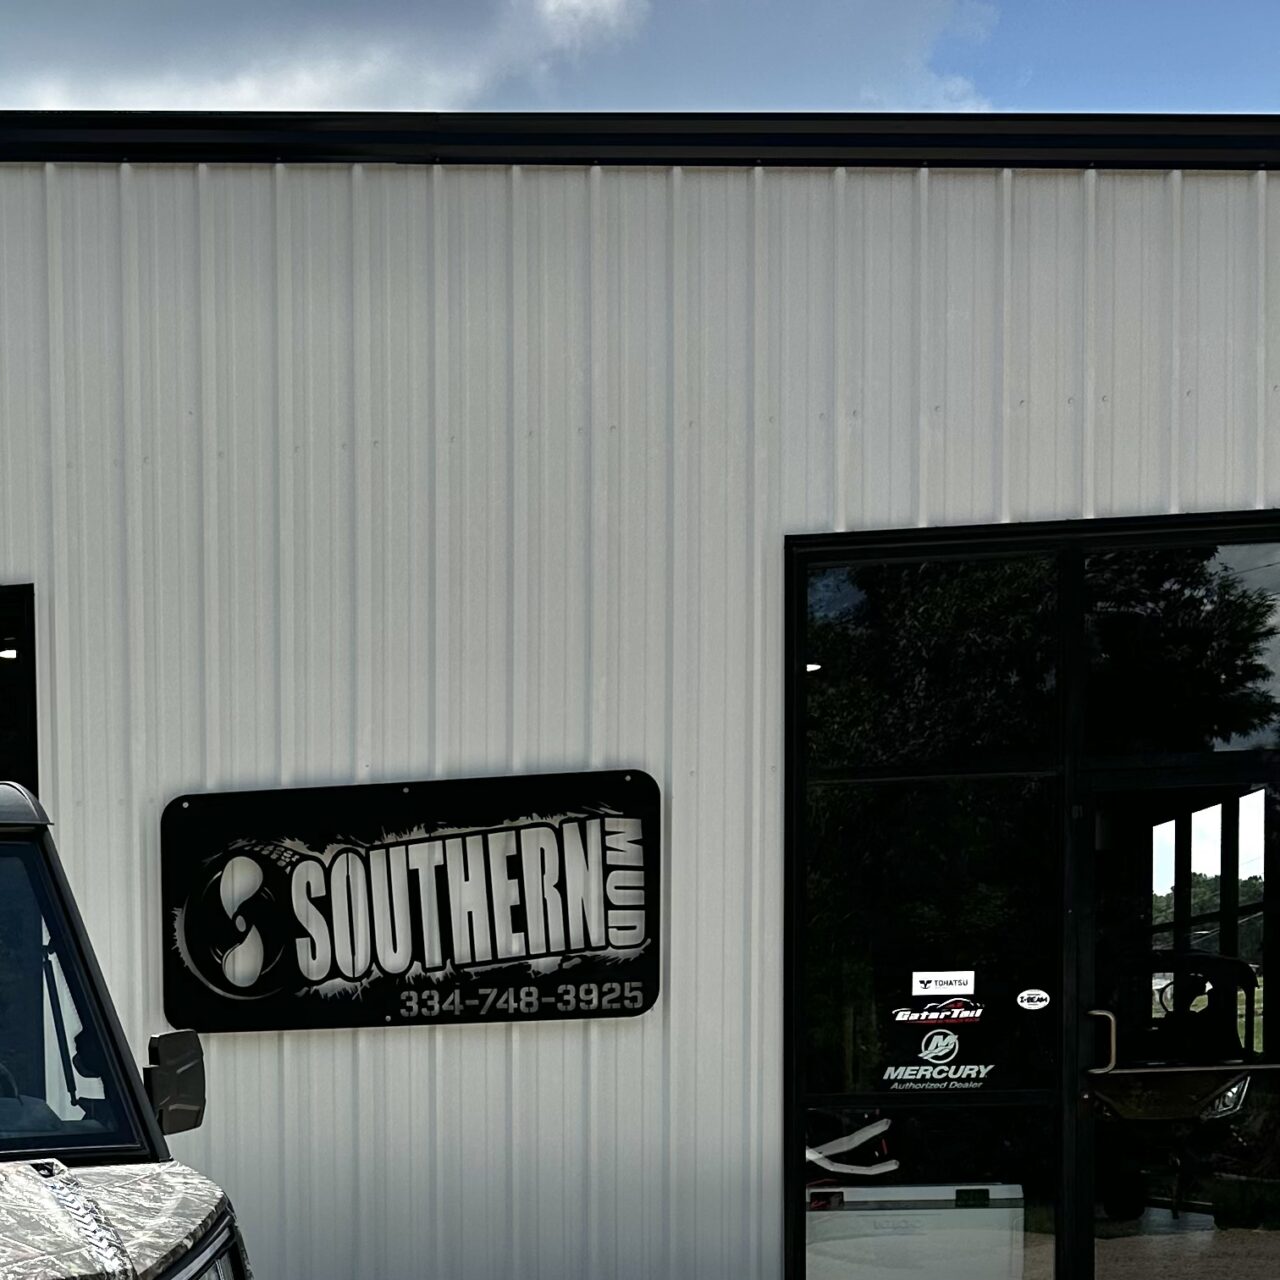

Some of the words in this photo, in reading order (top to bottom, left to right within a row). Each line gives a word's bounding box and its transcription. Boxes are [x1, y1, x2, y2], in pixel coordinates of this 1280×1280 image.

[605, 817, 646, 947] MUD
[291, 819, 606, 981] SOUTHERN
[934, 979, 969, 987] TOHATSU
[399, 981, 644, 1017] 334-748-3925
[883, 1065, 995, 1080] MERCURY
[890, 1081, 947, 1090] Authorized
[949, 1080, 983, 1089] Dealer
